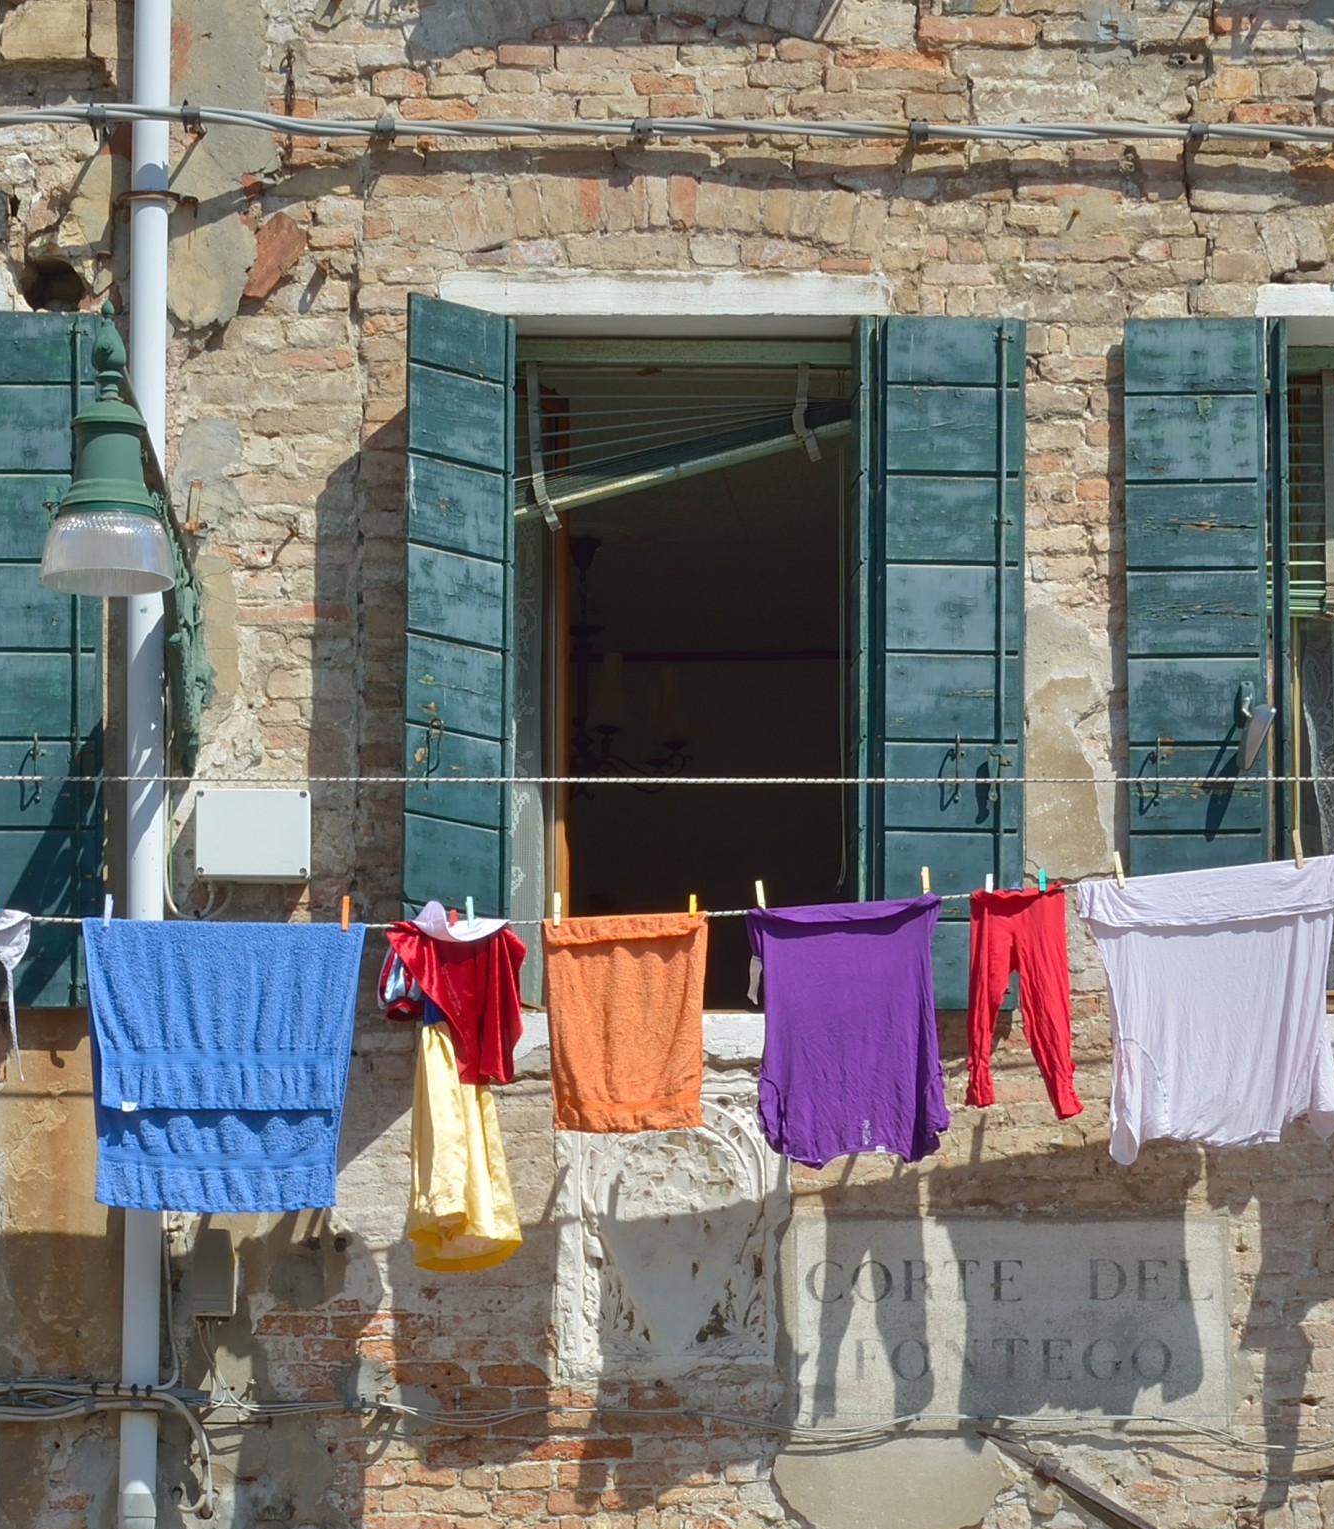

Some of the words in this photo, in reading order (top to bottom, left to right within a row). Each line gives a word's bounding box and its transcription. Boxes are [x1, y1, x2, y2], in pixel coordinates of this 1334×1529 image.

[805, 1259, 1024, 1304] CORTE
[1089, 1257, 1214, 1303] DEL
[855, 1338, 1174, 1382] FONTEGO
